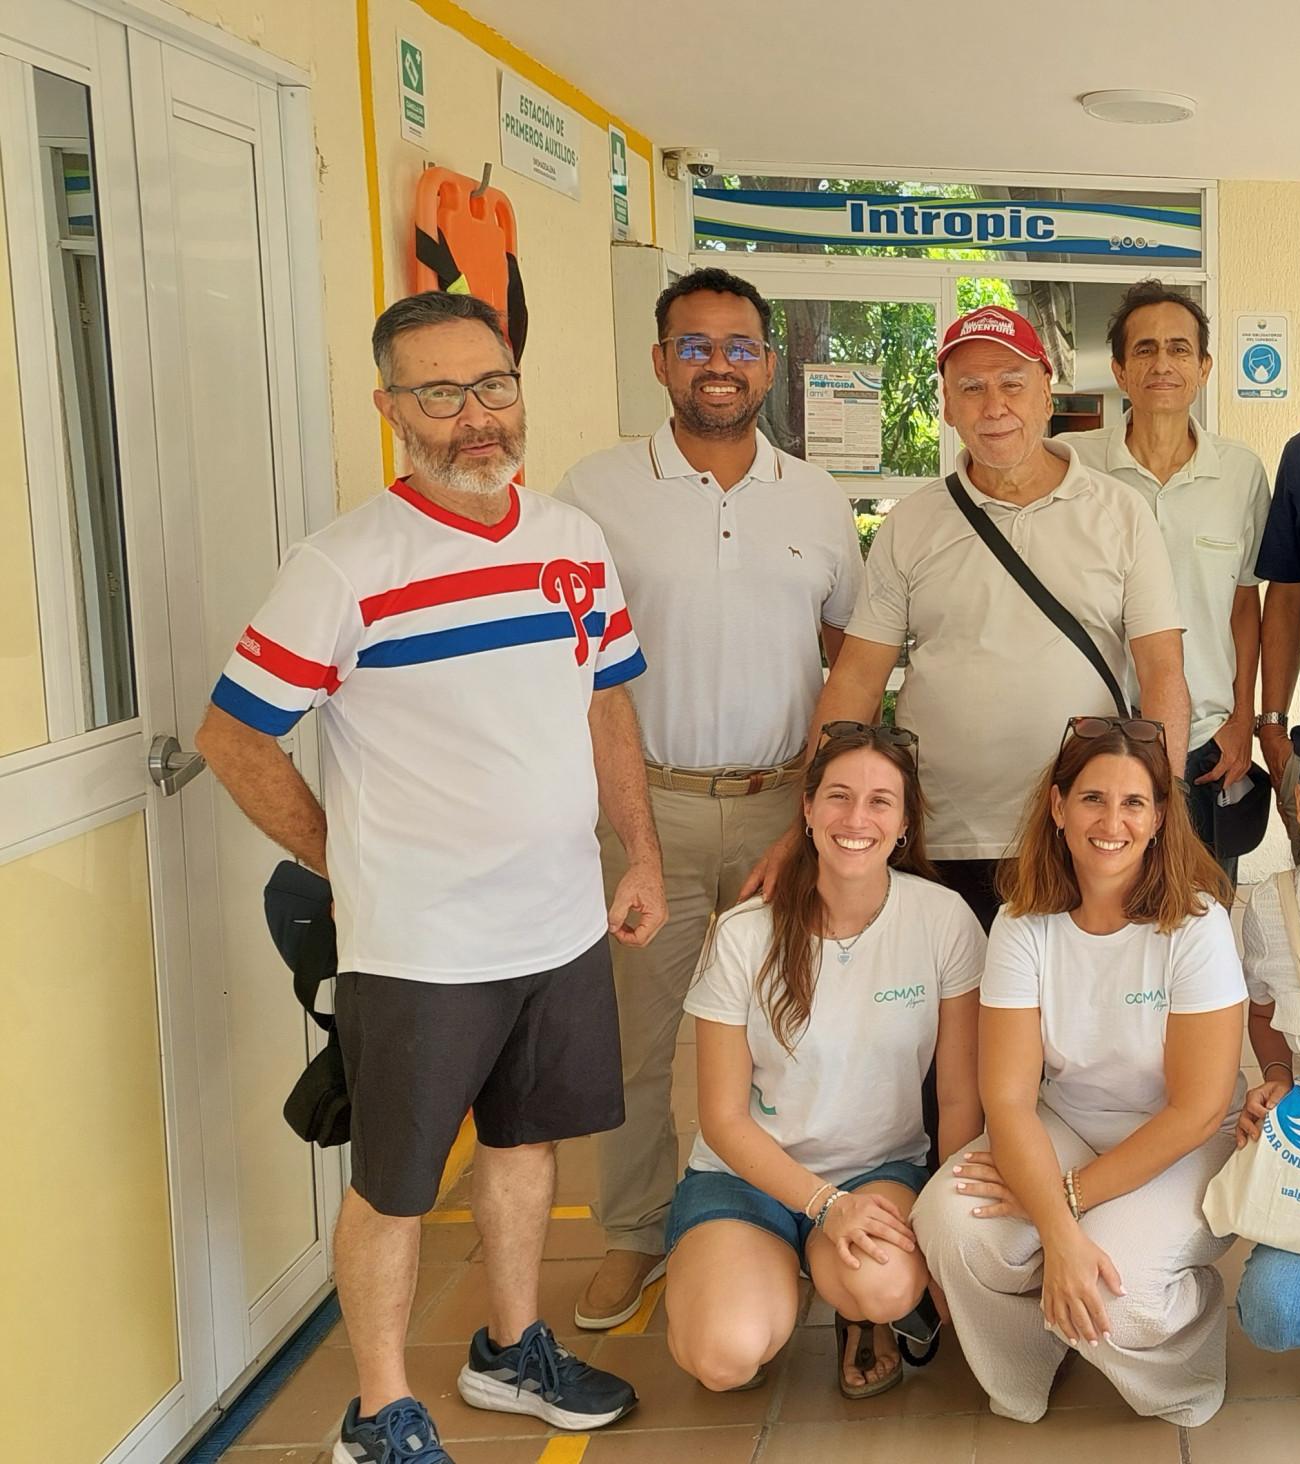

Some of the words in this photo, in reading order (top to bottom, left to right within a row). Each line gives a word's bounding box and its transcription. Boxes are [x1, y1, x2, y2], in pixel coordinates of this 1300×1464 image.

[520, 94, 555, 132] ESTACIÓN
[555, 116, 564, 137] DE
[505, 112, 544, 150] PRIMEROS
[545, 135, 576, 167] AUXILIOS
[850, 203, 1054, 240] Intropic
[960, 324, 1015, 336] ADVENTURE
[809, 381, 855, 389] PROTEGIDA
[873, 984, 926, 1003] CCMAR
